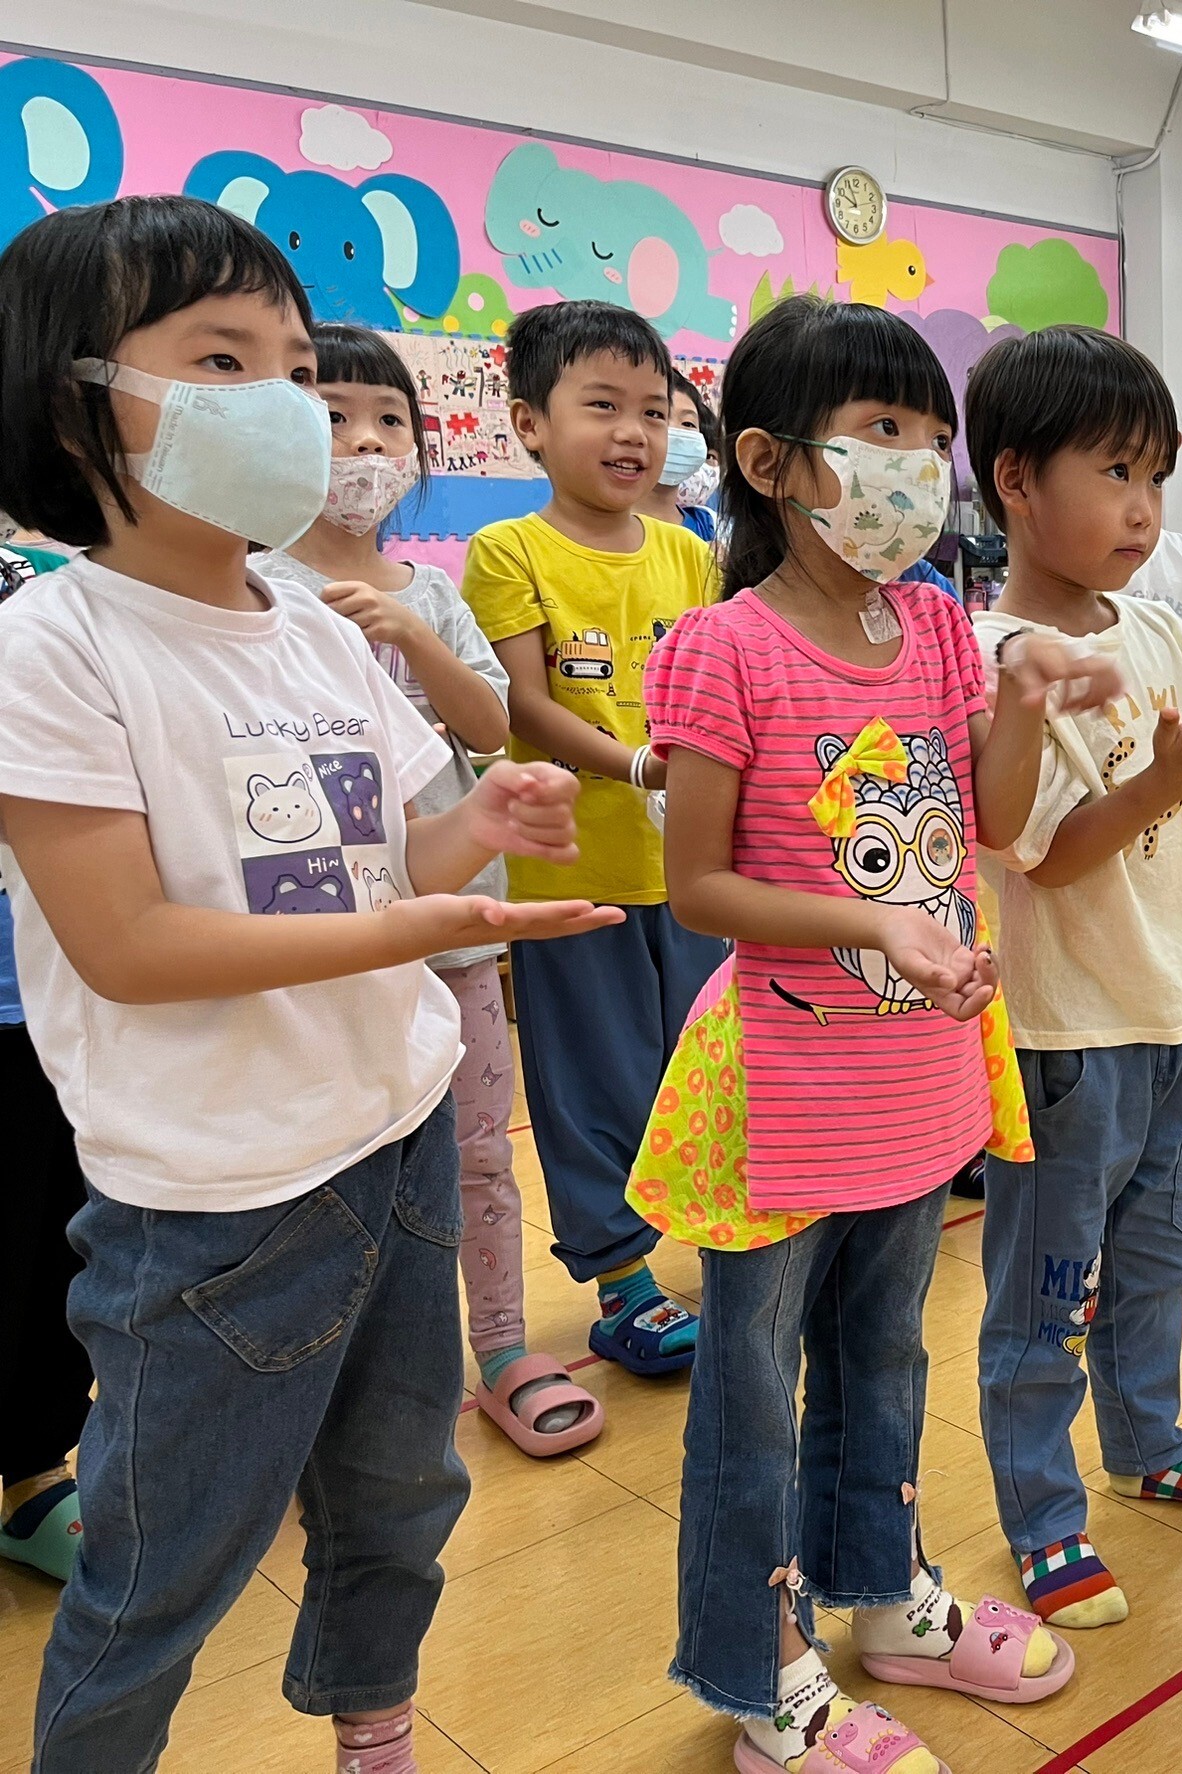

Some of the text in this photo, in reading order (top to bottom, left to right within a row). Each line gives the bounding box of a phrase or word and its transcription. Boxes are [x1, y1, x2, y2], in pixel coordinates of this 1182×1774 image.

[853, 178, 860, 188] 12
[863, 182, 868, 192] 1
[837, 187, 846, 198] 10
[868, 192, 875, 202] 2
[835, 198, 841, 208] 9
[871, 204, 877, 214] 3
[838, 210, 844, 220] 8
[868, 215, 874, 225] 4
[845, 220, 850, 229] 7
[853, 224, 859, 234] 6
[862, 222, 868, 232] 5
[224, 712, 369, 742] Lucky Bear
[318, 759, 343, 779] Nice
